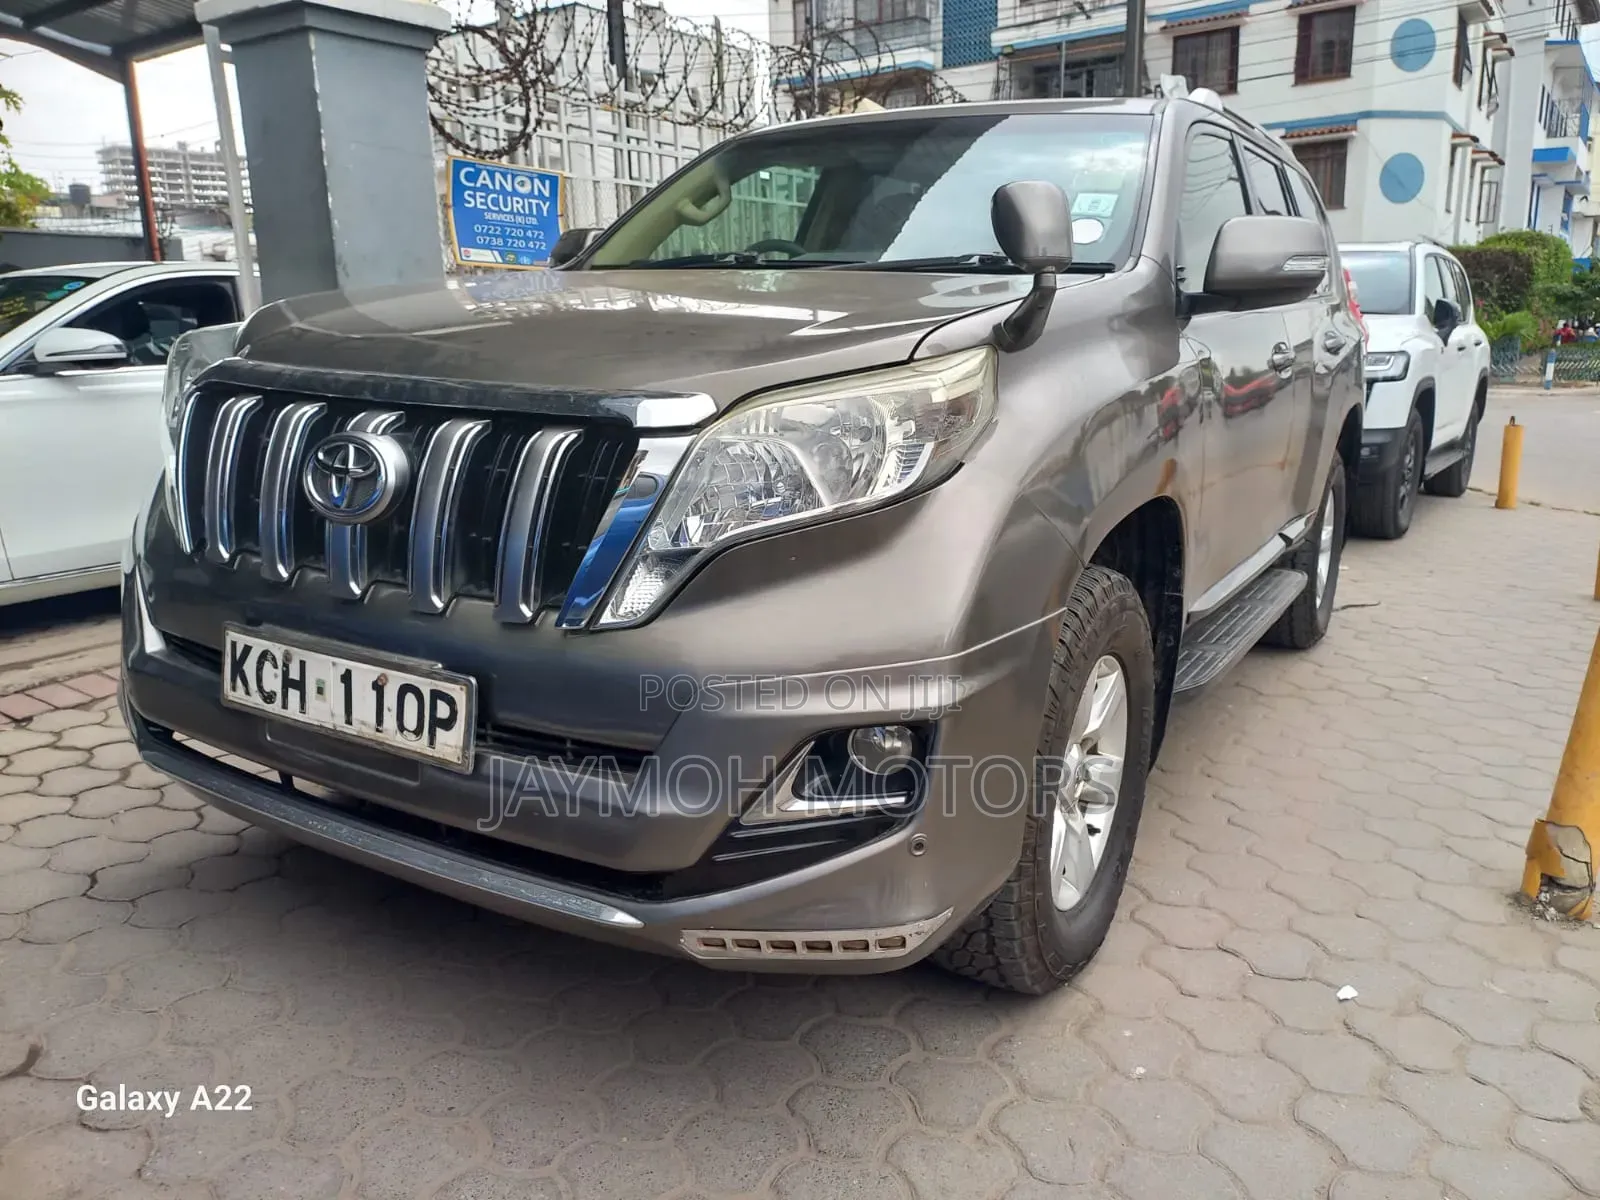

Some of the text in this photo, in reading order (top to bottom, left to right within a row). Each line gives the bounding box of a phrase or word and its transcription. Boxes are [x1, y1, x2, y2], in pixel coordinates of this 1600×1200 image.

[460, 167, 550, 198] CANON
[463, 190, 550, 217] SECURITY
[484, 211, 514, 223] SERVICES
[474, 224, 545, 239] 0722 720 472
[476, 235, 547, 250] 0738 720 472
[230, 640, 307, 714] KCH
